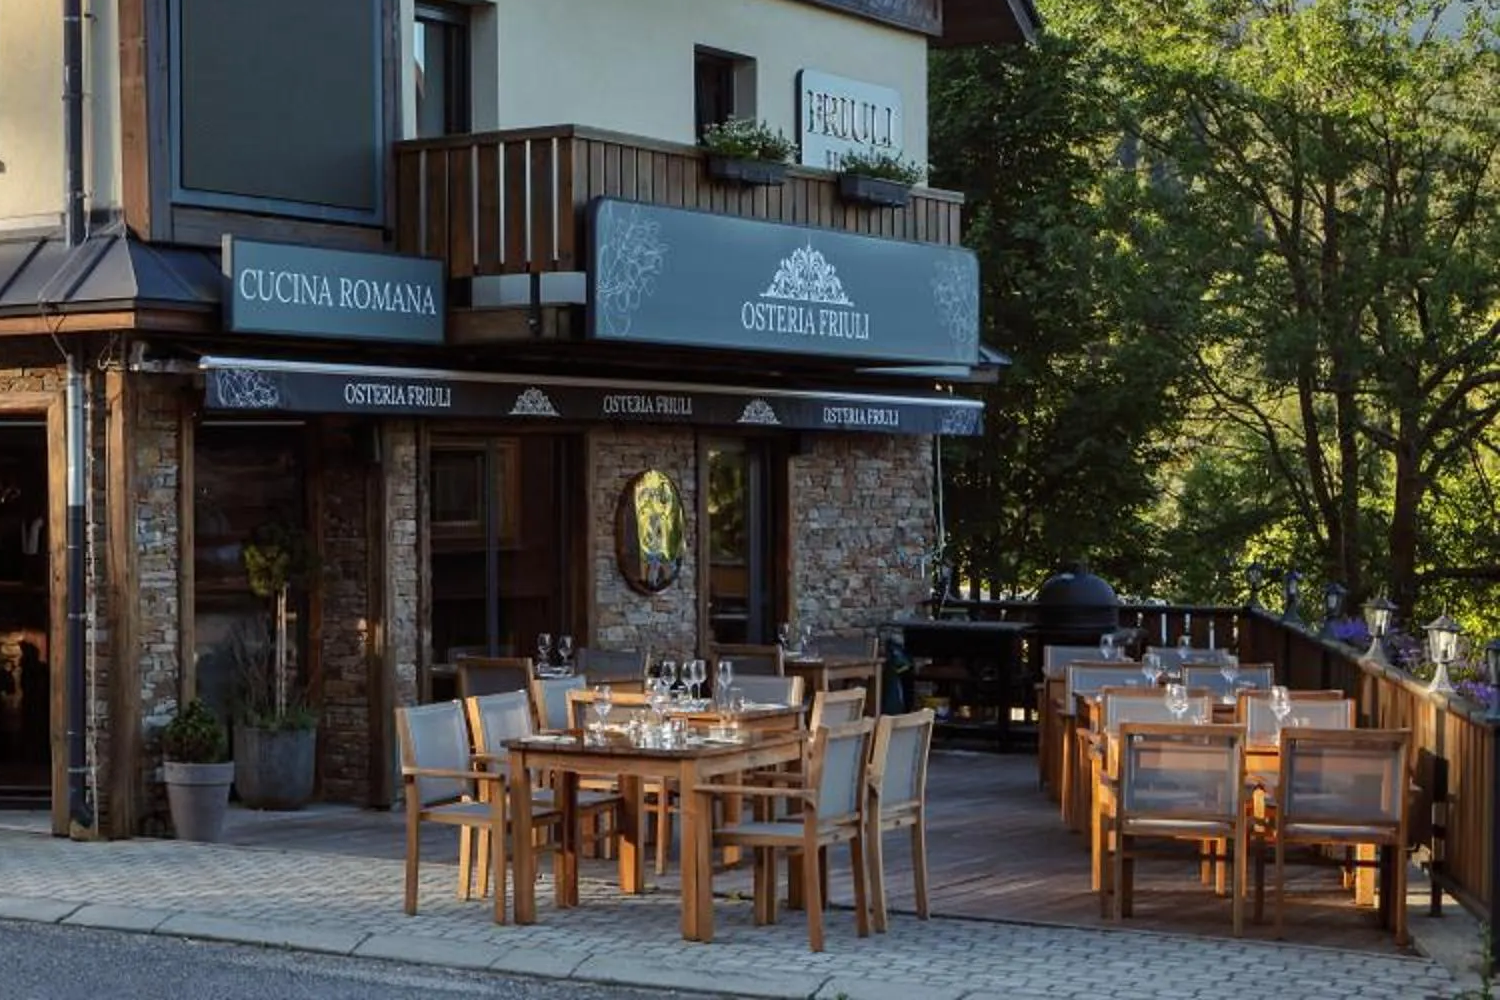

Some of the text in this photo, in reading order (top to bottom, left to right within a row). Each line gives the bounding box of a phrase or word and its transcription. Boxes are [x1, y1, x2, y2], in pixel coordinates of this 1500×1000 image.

[806, 89, 892, 149] FRIULI
[239, 268, 437, 315] CUCINA ROMANA
[741, 301, 870, 341] OSTERIA FRIULI
[344, 383, 451, 408] OSTERIA FRIULI
[603, 394, 653, 414] OSTERIA
